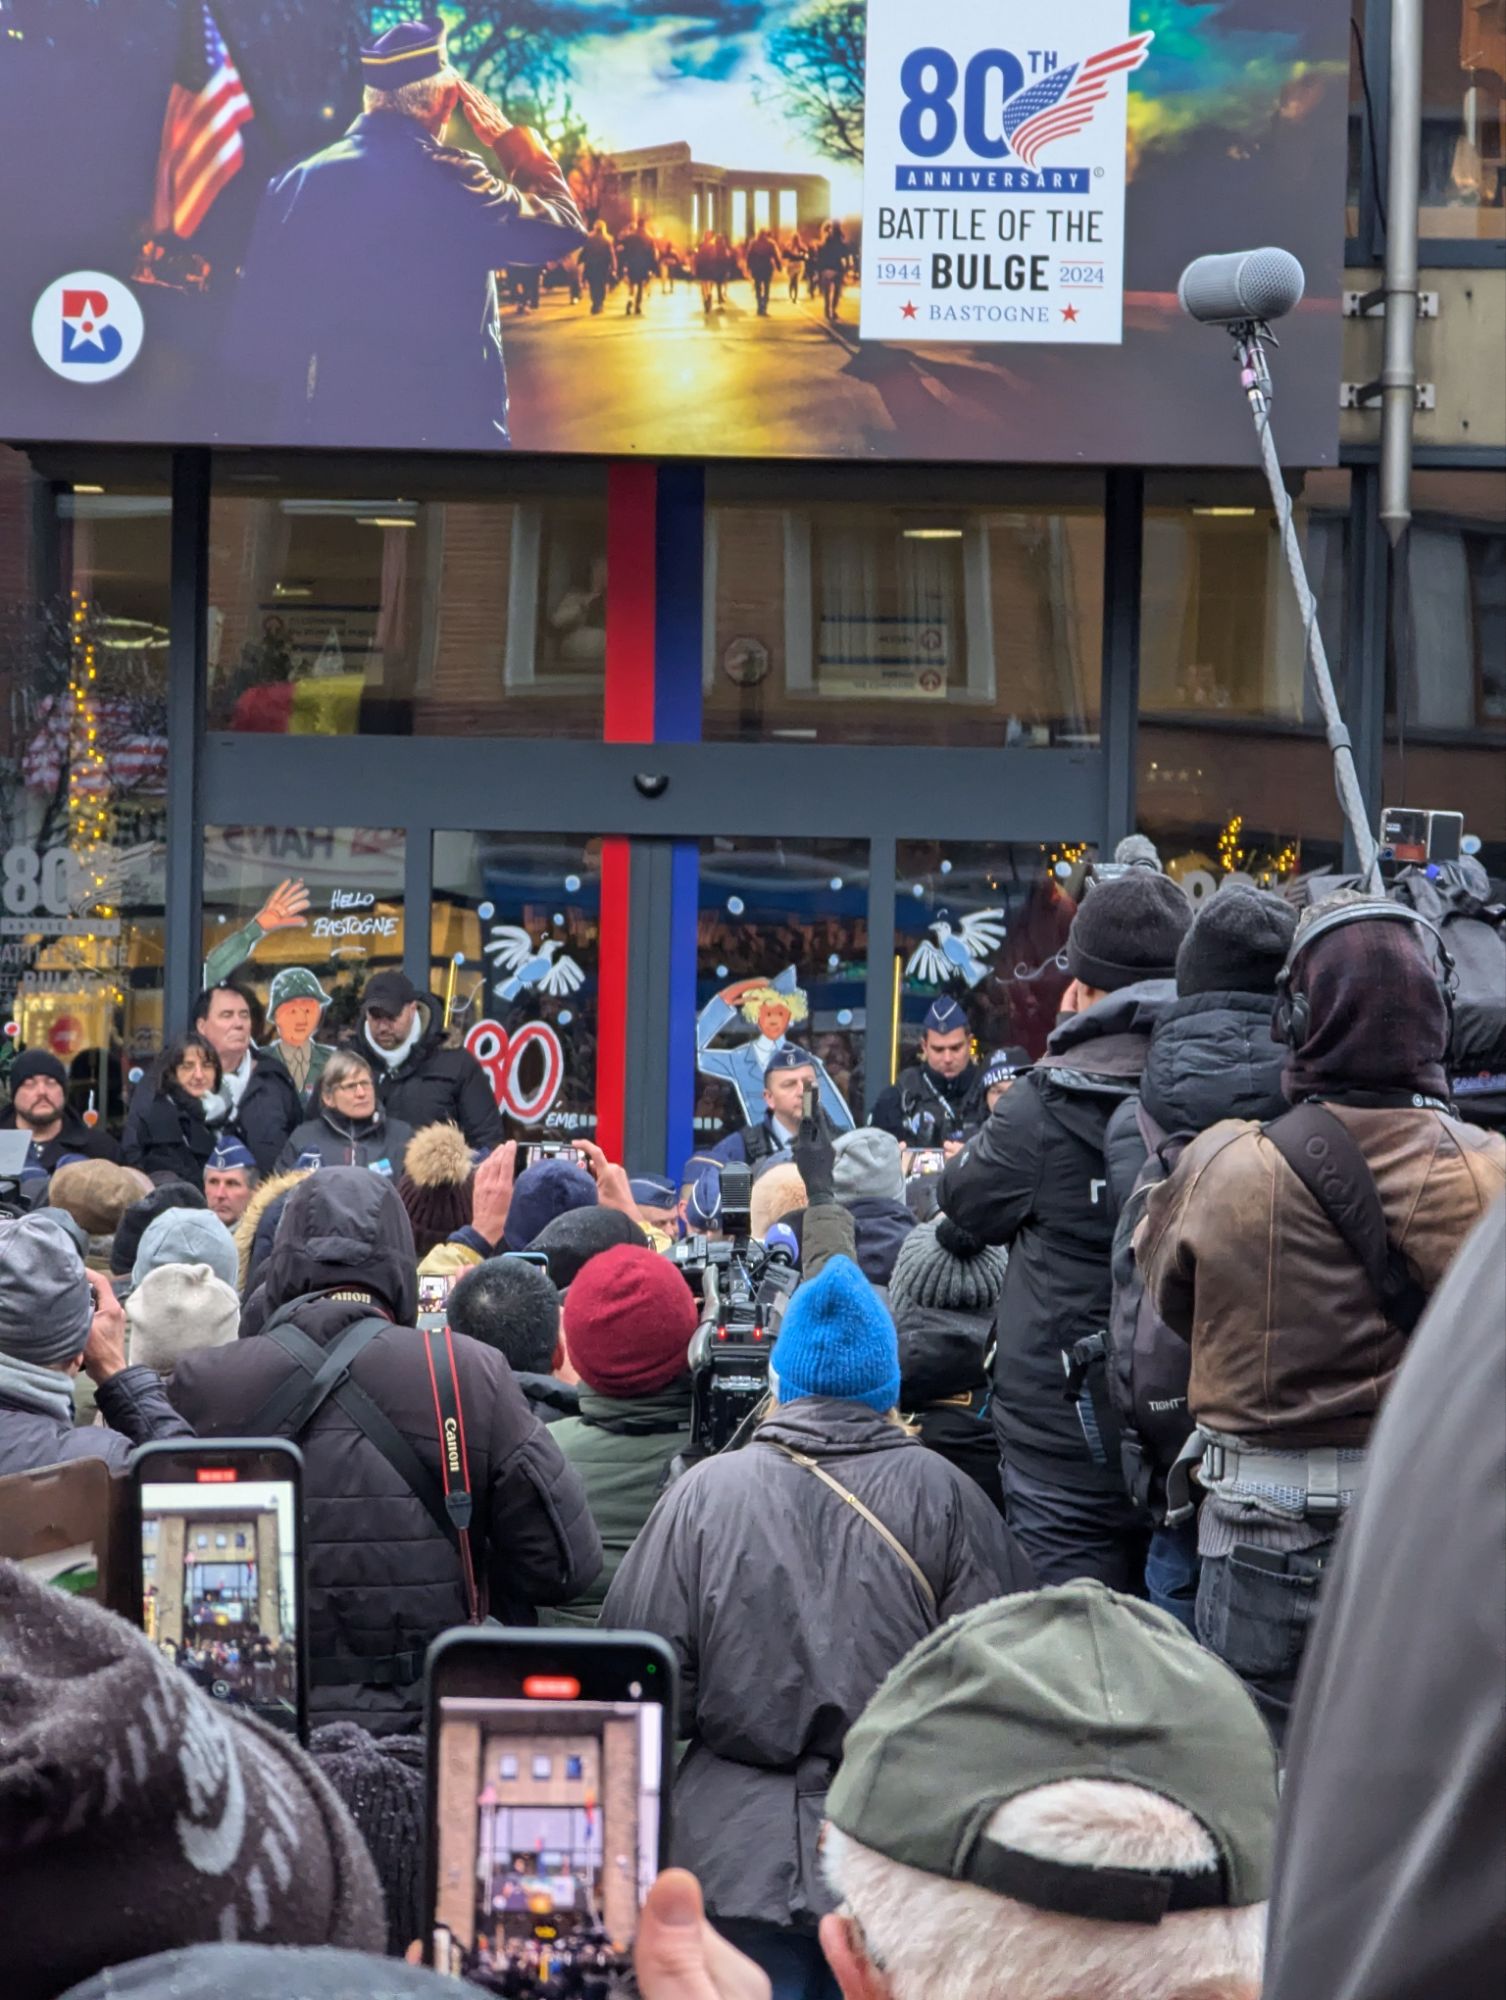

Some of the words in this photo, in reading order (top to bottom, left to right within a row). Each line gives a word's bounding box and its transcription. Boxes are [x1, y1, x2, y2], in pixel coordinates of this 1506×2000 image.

[899, 46, 1024, 159] 80
[1027, 50, 1057, 74] TH
[907, 170, 1079, 188] ANNIVERSARY
[878, 207, 986, 241] BATTLE
[998, 209, 1036, 242] OF
[1046, 210, 1104, 243] THE
[876, 263, 921, 280] 1944
[931, 253, 1050, 292] BULGE
[1059, 266, 1105, 283] 2024
[929, 304, 1049, 323] BASTOGNE
[330, 888, 375, 910] HELLO
[311, 916, 400, 938] BASTOGNE
[320, 1291, 371, 1304] anon
[444, 1416, 460, 1472] Canon
